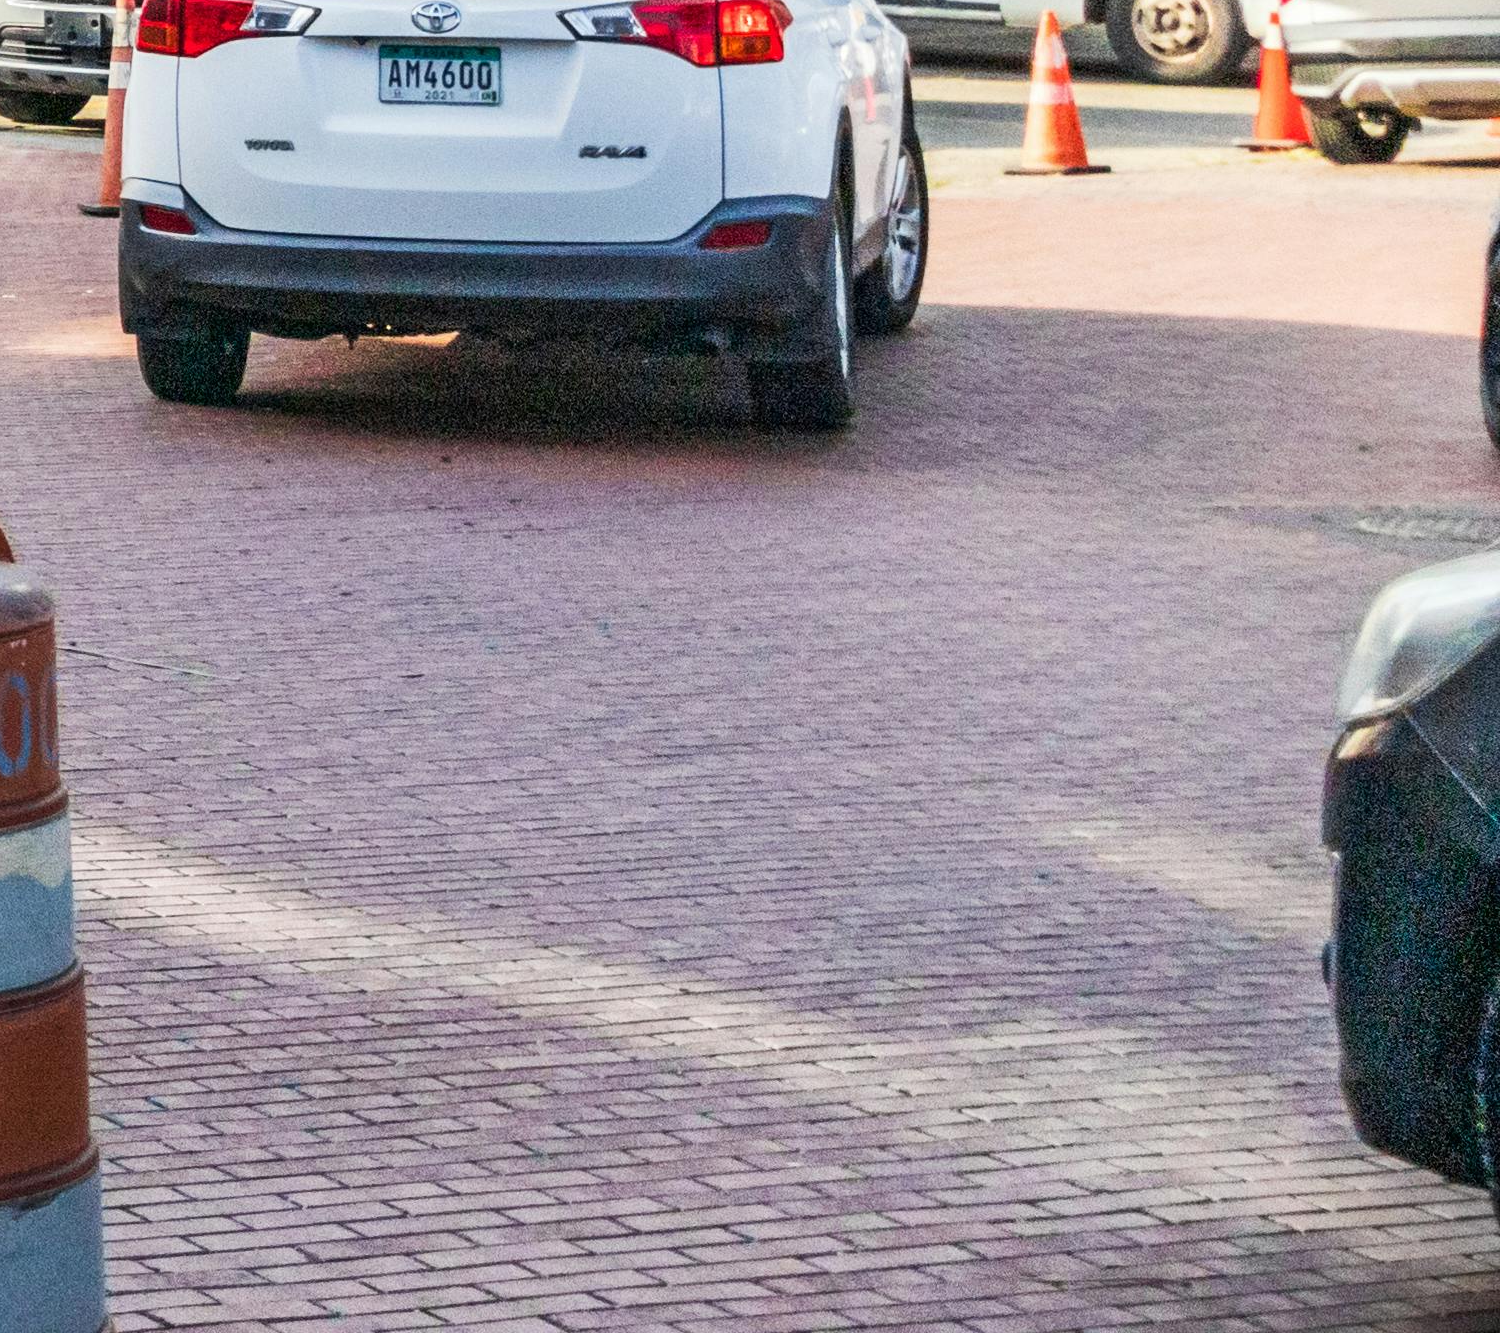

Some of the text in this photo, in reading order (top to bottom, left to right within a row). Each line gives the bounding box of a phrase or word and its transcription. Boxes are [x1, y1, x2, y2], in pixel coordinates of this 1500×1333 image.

[388, 60, 492, 90] AM4600
[425, 90, 454, 100] 2021
[579, 145, 647, 159] RAV4
